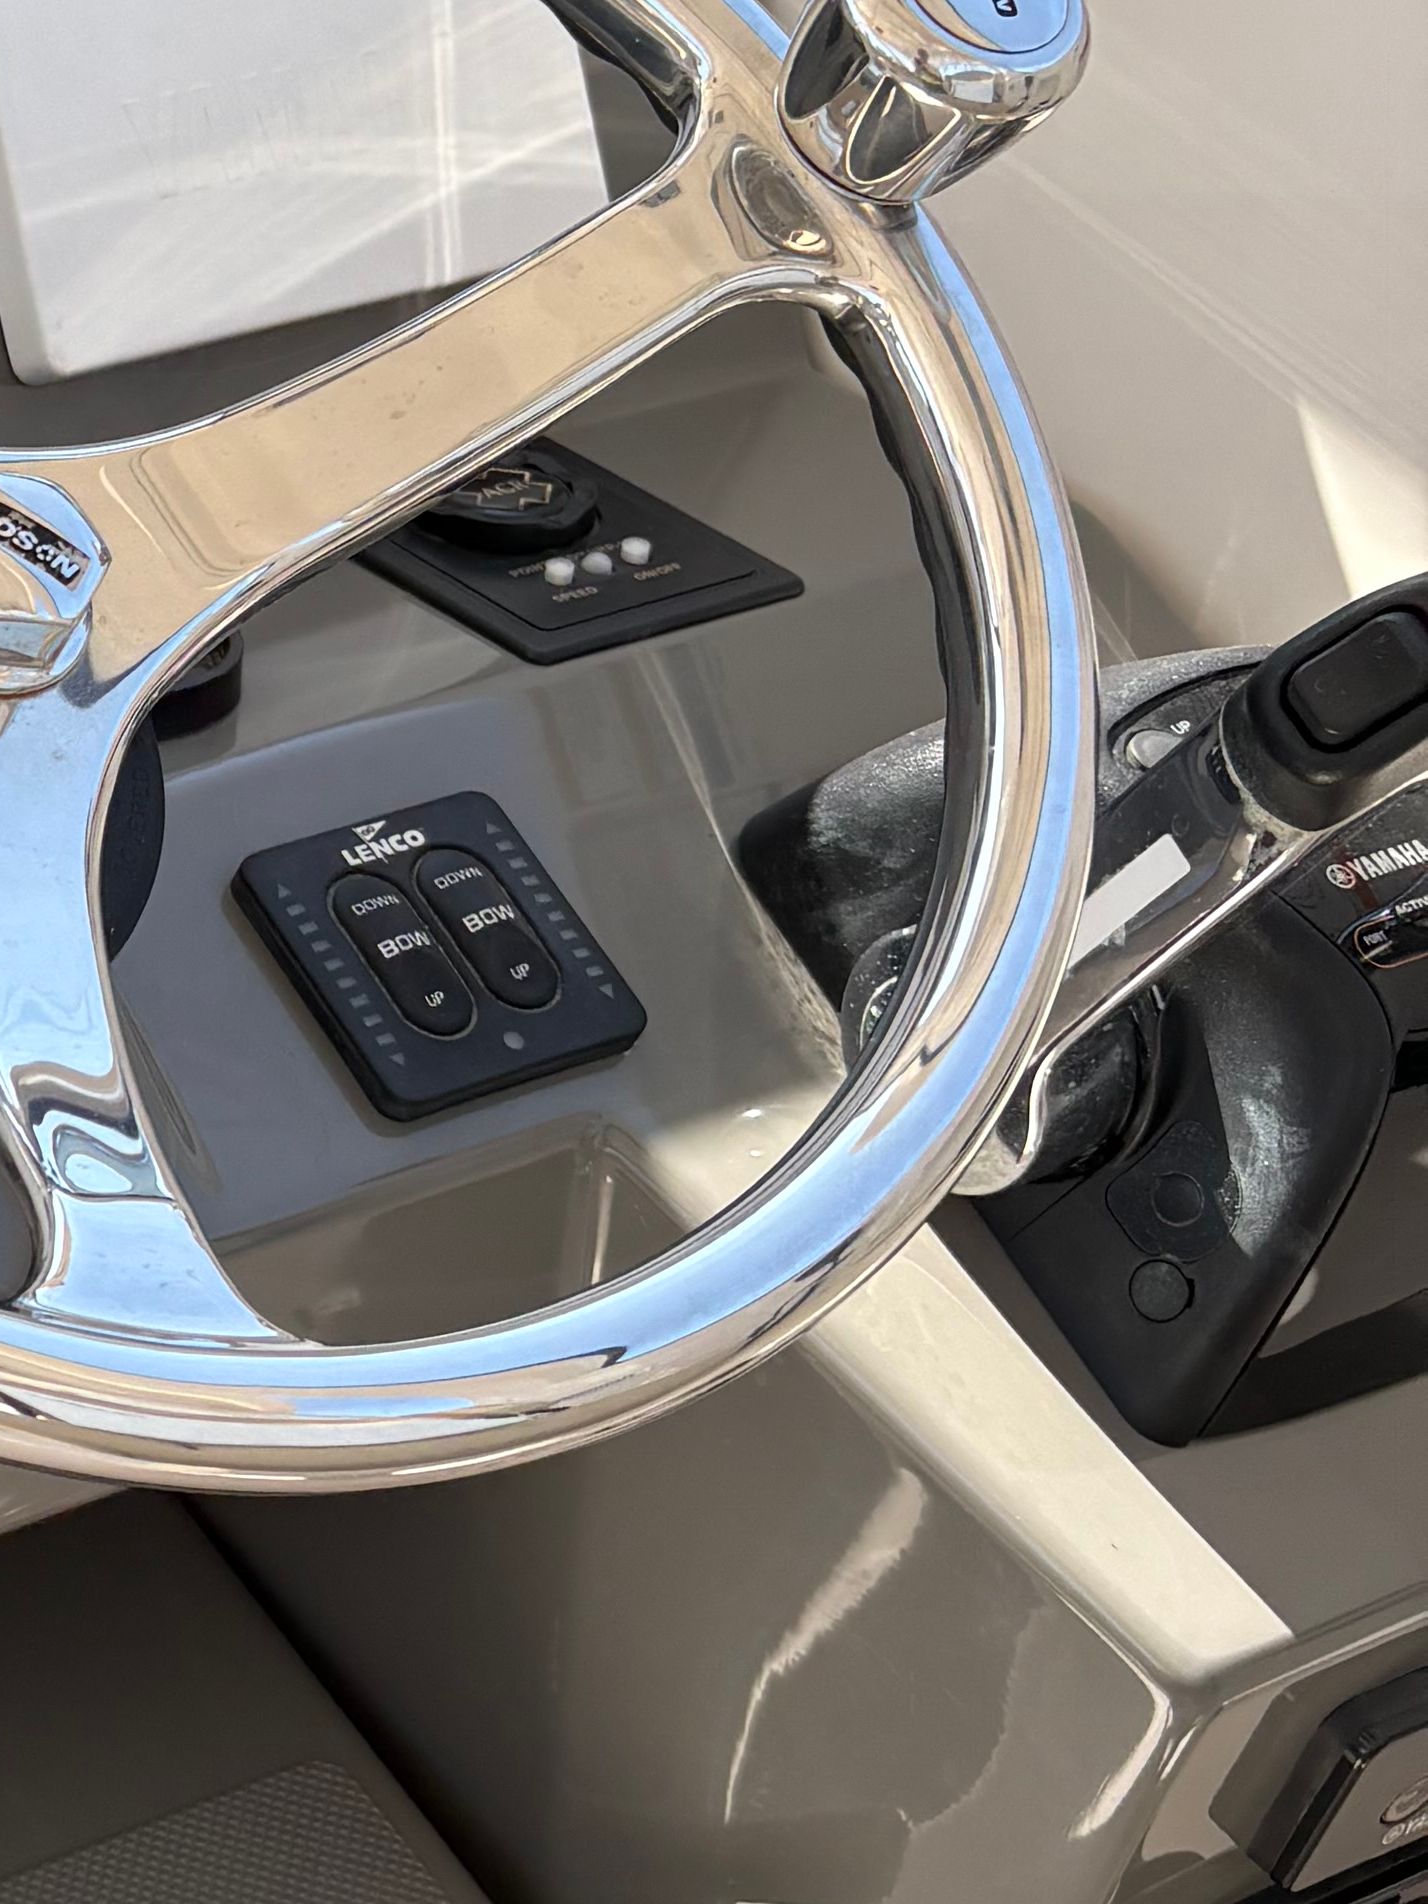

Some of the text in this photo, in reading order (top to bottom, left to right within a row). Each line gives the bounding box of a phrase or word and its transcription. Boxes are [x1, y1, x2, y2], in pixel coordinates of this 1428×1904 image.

[1170, 720, 1191, 735] UP
[341, 829, 426, 866] LENCO
[1345, 839, 1428, 881] YAMAHA
[433, 864, 483, 890] DOWN
[351, 893, 399, 916] DOWN
[462, 903, 515, 933] BOW
[377, 930, 431, 959] BOW
[1362, 930, 1389, 946] PORT
[510, 963, 530, 981] UP
[425, 990, 445, 1008] UP
